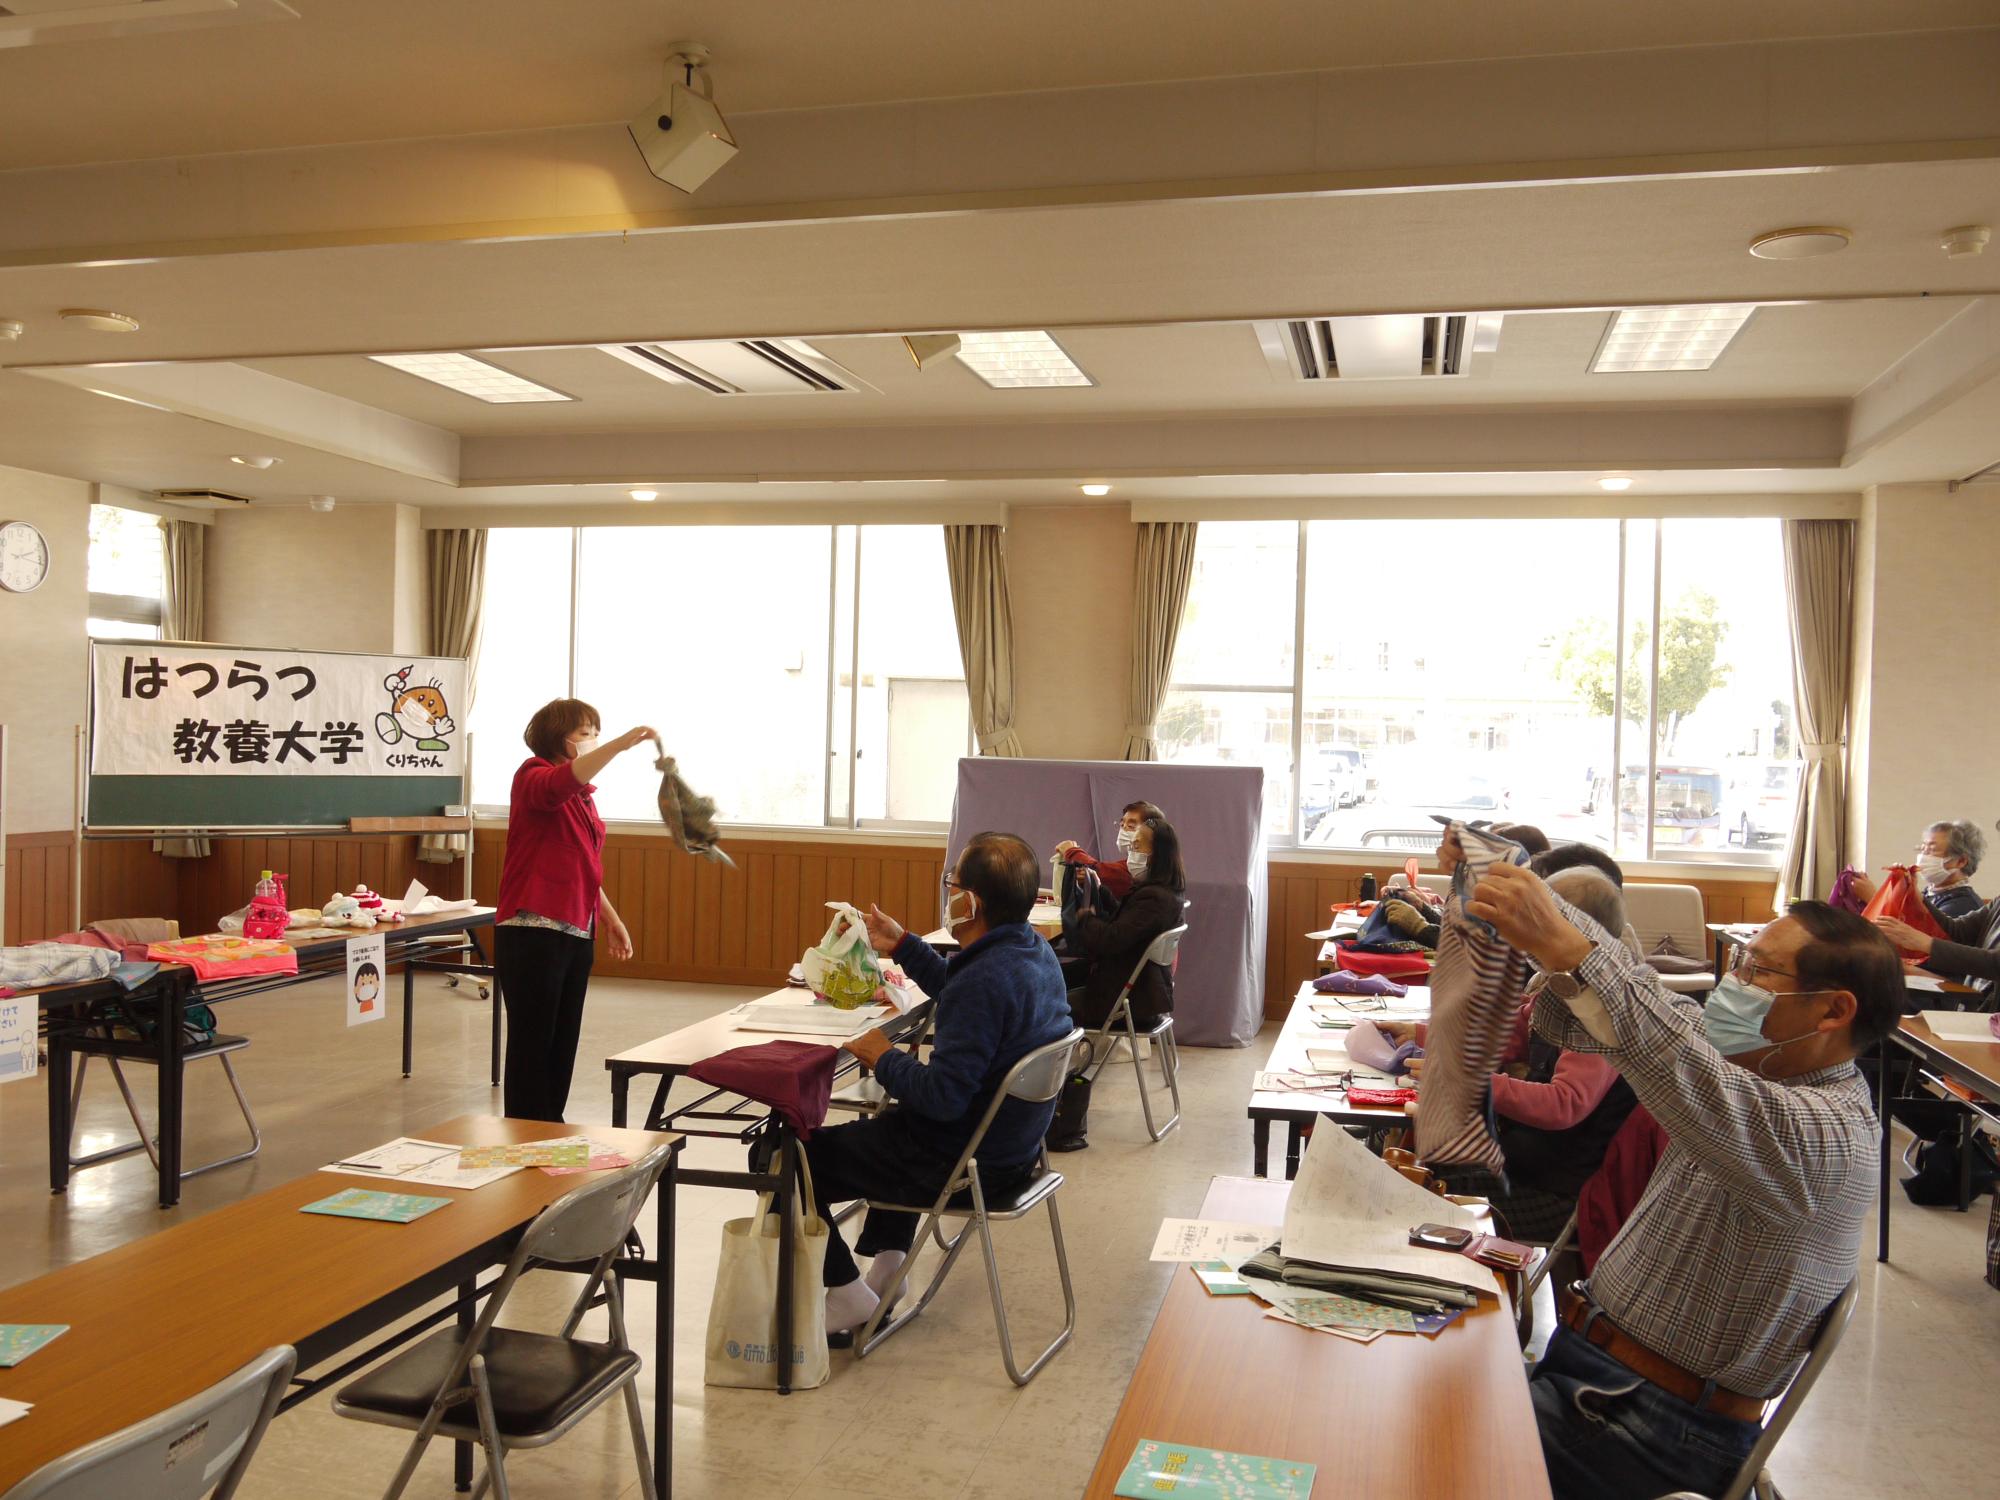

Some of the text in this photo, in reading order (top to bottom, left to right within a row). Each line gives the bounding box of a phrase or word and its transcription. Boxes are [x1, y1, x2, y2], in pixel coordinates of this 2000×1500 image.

[122, 656, 317, 701] はつらつ
[173, 718, 364, 764] 教養大学
[385, 753, 443, 768] くりちゃん
